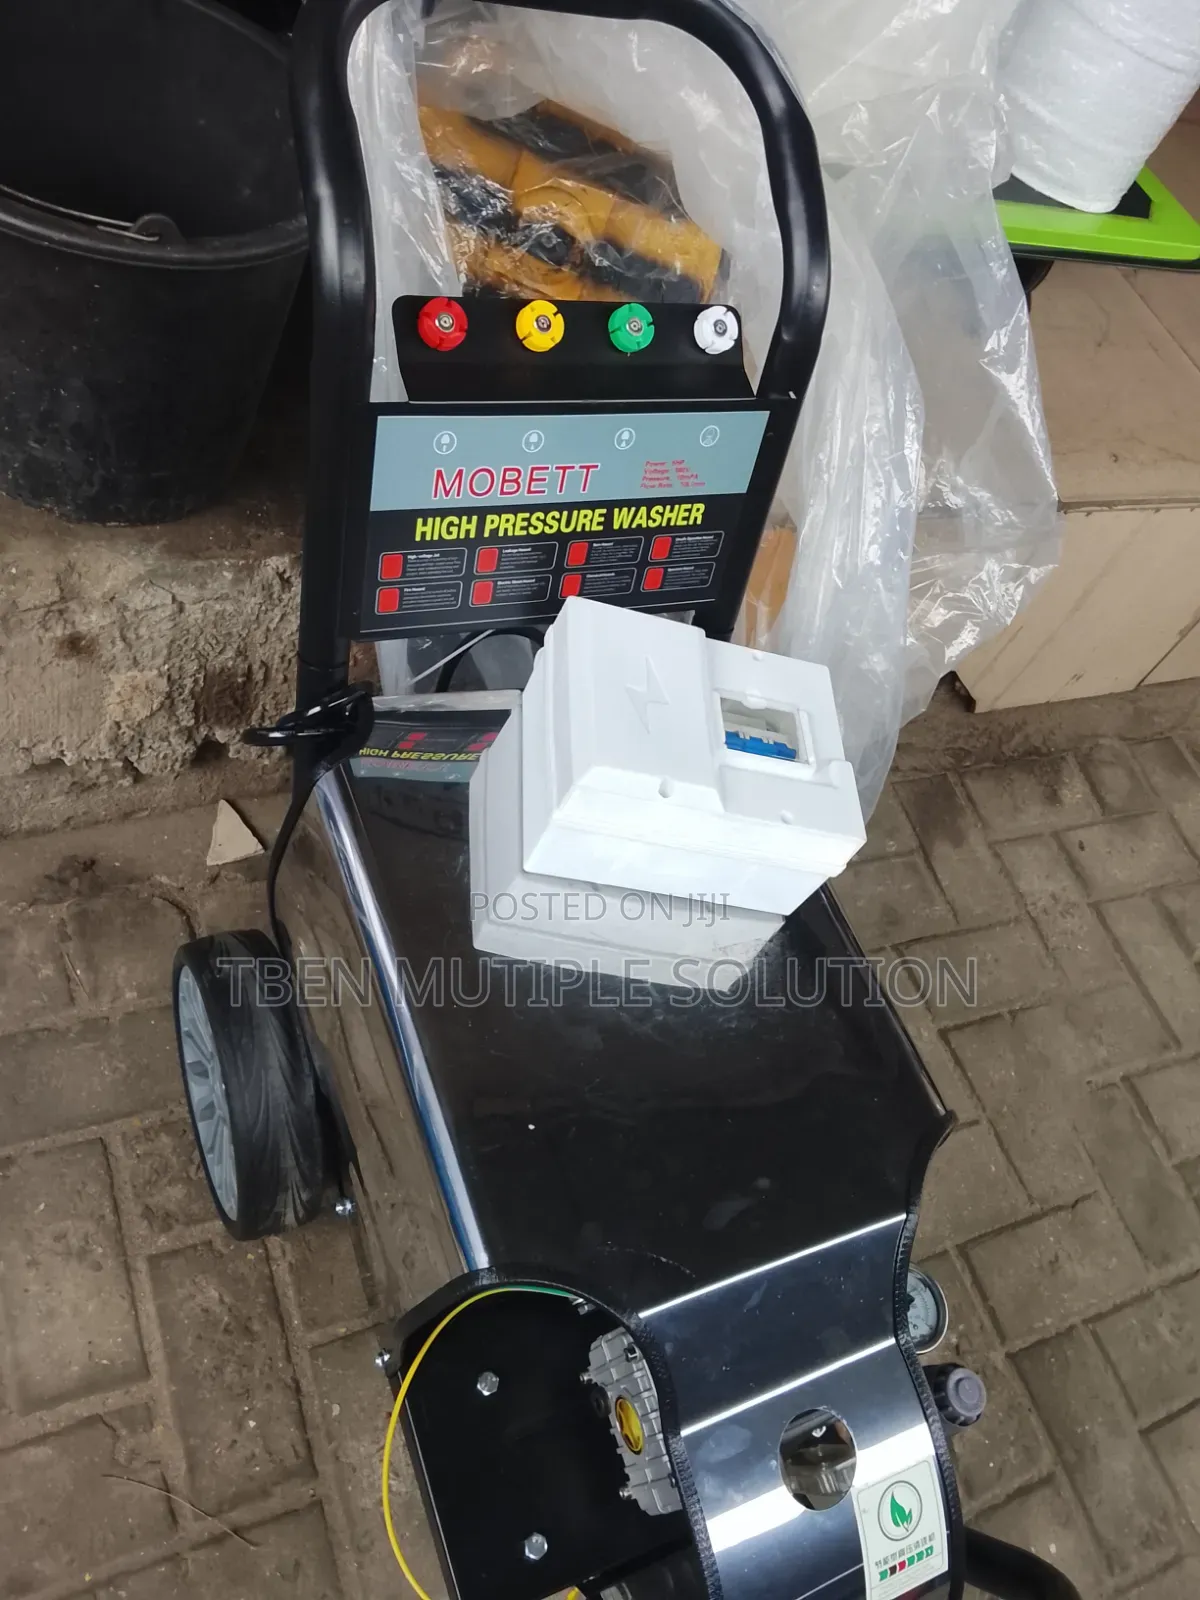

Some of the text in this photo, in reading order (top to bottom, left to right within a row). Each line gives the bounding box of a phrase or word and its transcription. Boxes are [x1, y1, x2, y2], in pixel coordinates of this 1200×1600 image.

[431, 463, 600, 499] MOBETT
[415, 503, 706, 541] HIGH PRESSURE WASHER
